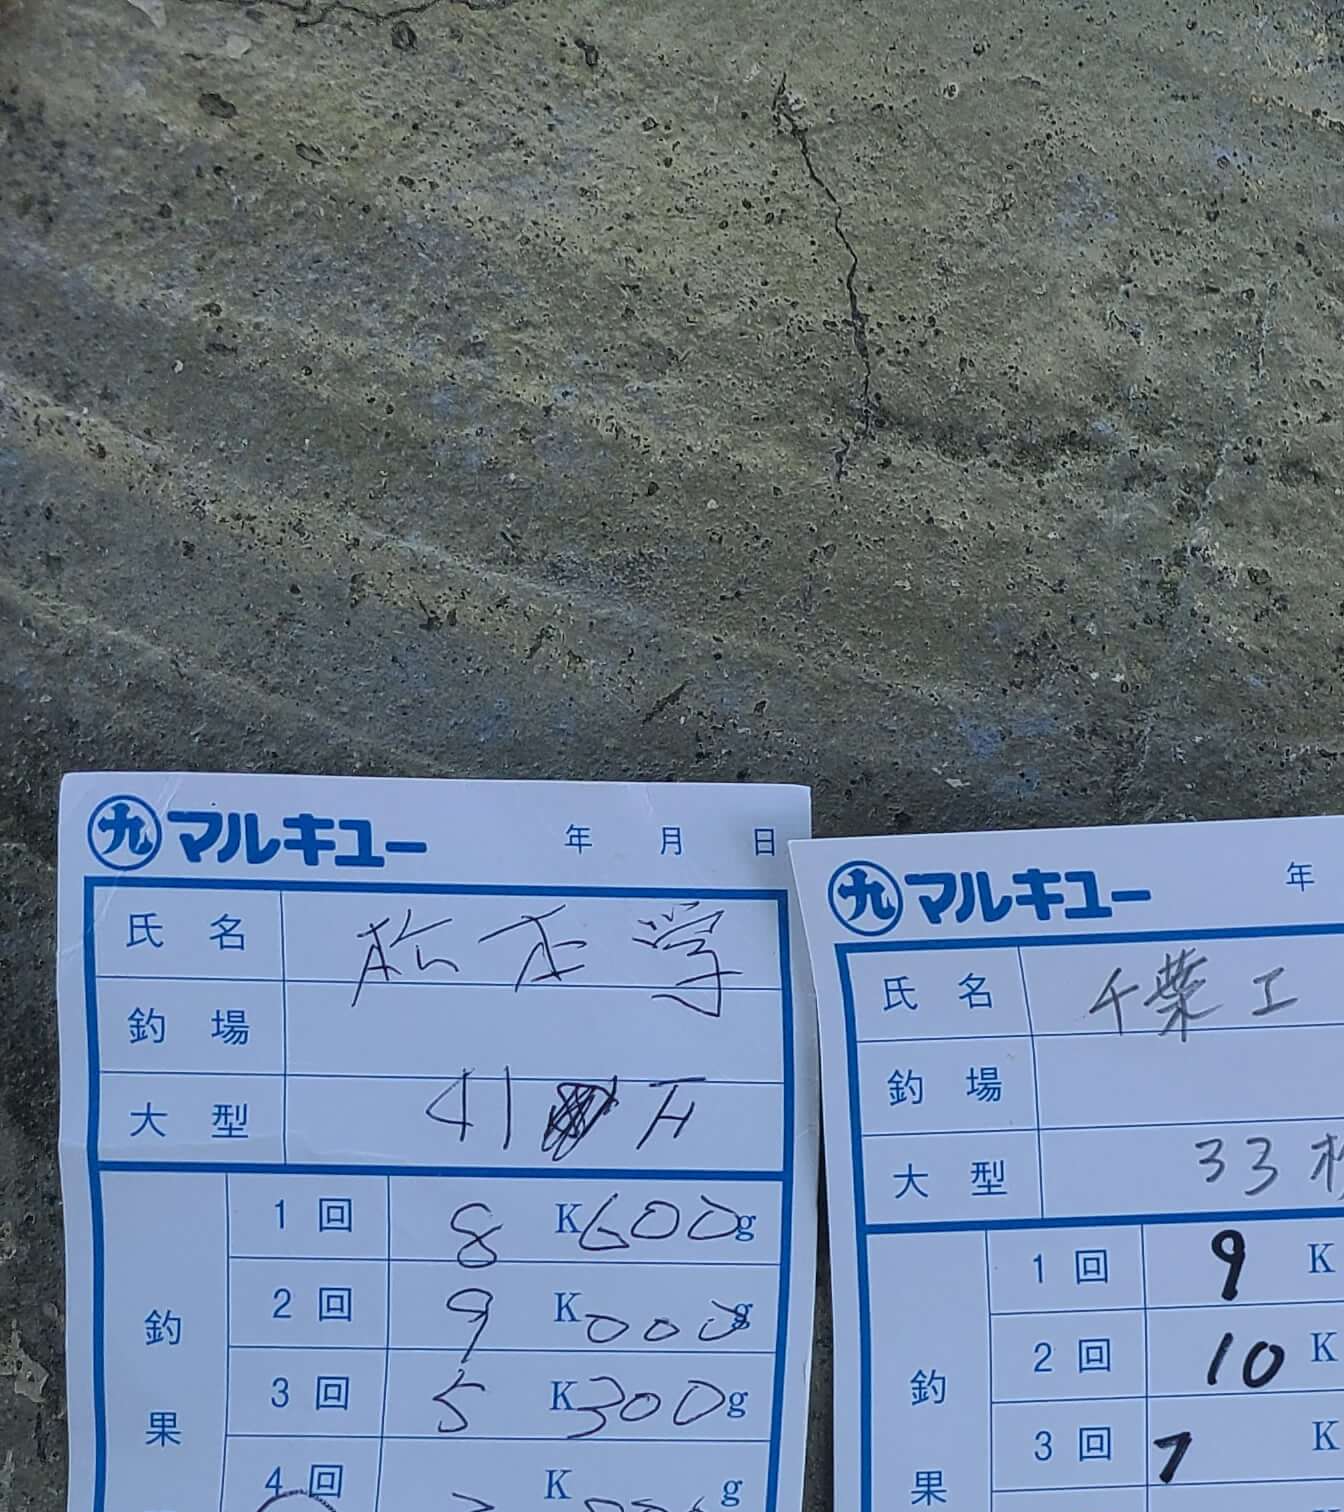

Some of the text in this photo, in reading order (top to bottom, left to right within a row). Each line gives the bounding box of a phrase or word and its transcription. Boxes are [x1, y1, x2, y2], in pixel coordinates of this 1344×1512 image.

[166, 810, 428, 868] マルキュー
[564, 823, 775, 857] 年 月 日
[1285, 861, 1315, 892] 年
[901, 868, 1152, 925] マルキュー
[126, 912, 245, 951] 氏名
[883, 972, 993, 1012] 氏名
[127, 1007, 250, 1046] 釣場
[887, 1066, 1002, 1107] 釣場
[130, 1101, 249, 1139] 大型
[893, 1159, 1008, 1199] 大型
[274, 1197, 353, 1233] 1回
[449, 1203, 504, 1269] 8
[1033, 1248, 1109, 1285] 1回
[1210, 1230, 1247, 1302] 9
[272, 1287, 353, 1323] 2回
[1033, 1338, 1111, 1374] 2回
[1205, 1331, 1285, 1389] 10
[271, 1375, 350, 1411] 3回
[1034, 1426, 1112, 1462] 3回
[262, 1463, 345, 1500] 4回
